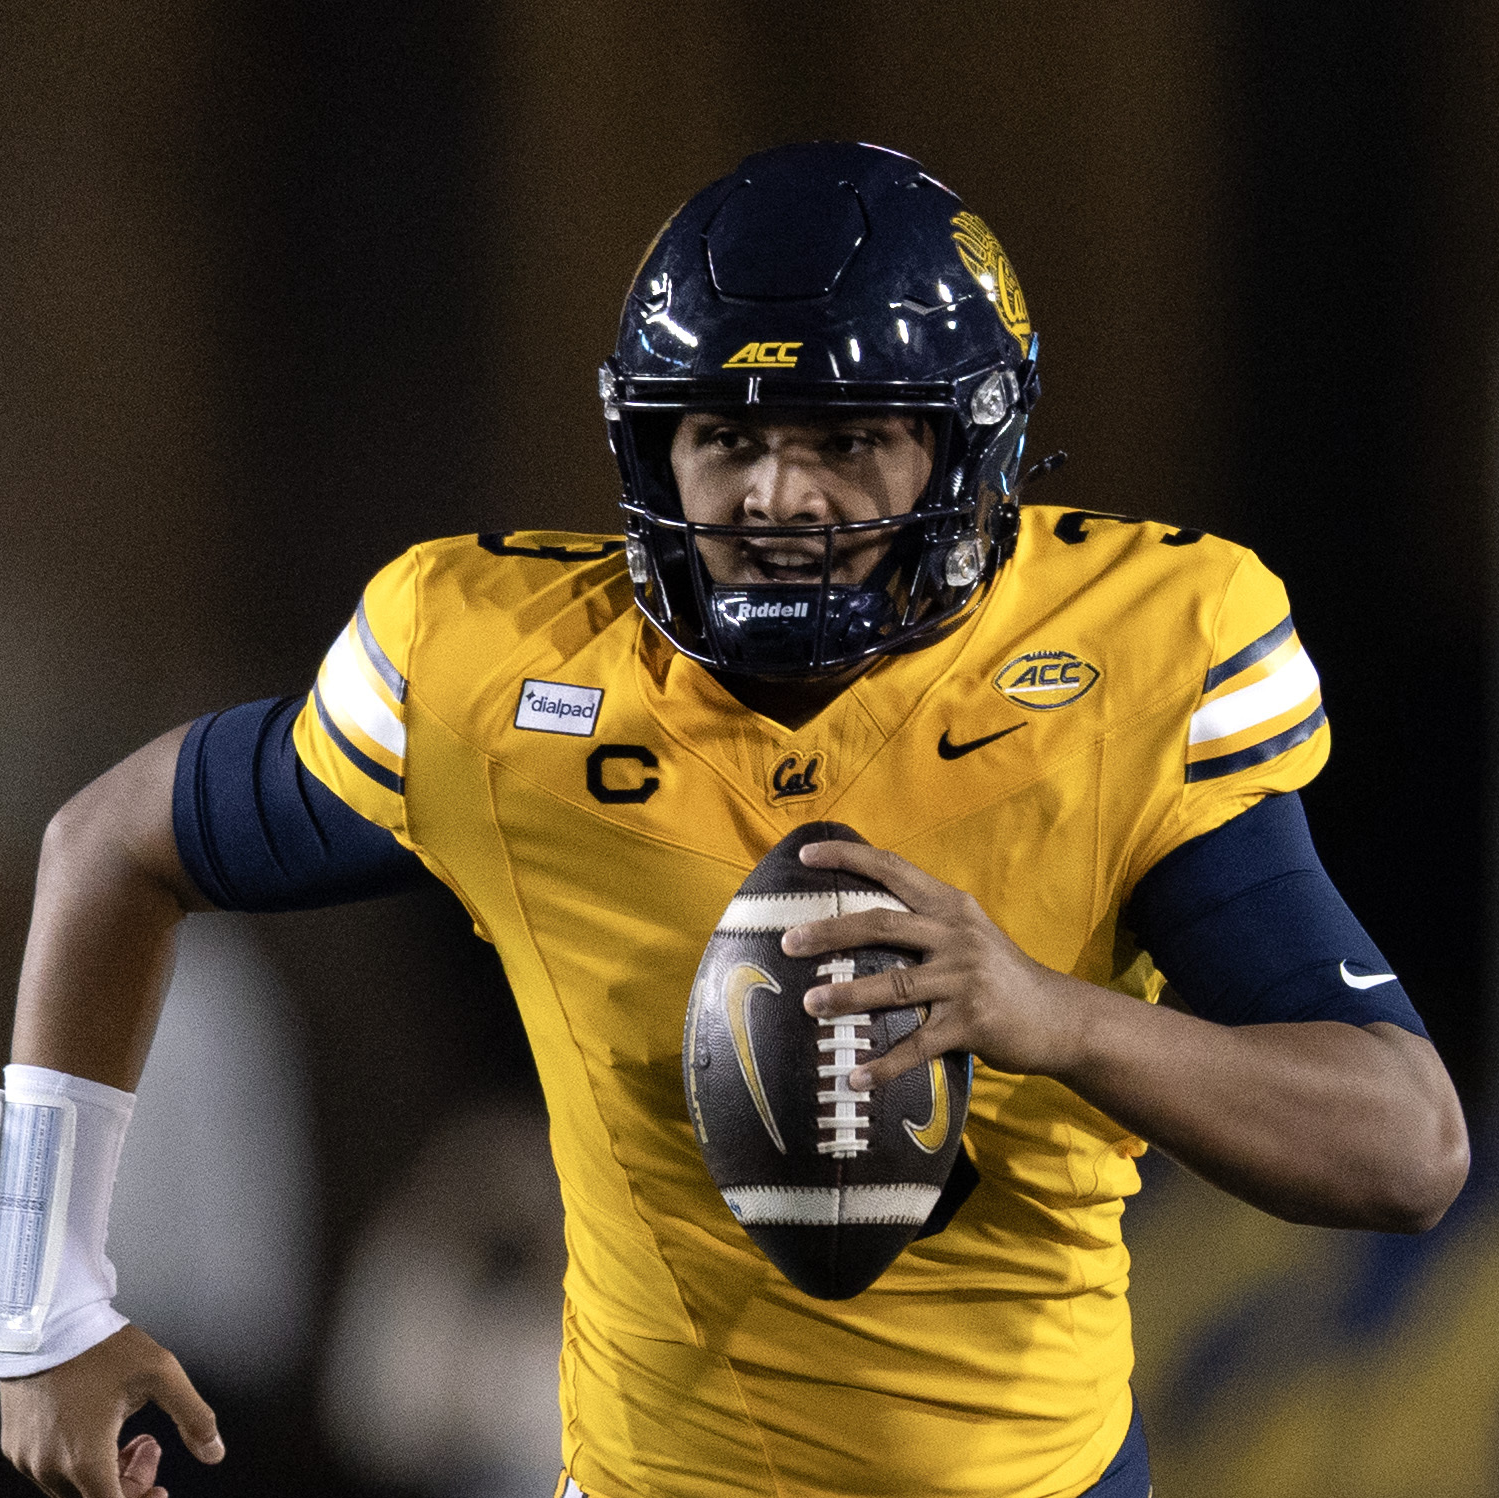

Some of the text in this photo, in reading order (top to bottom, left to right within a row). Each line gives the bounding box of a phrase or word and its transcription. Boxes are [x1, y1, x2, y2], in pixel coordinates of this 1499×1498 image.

[722, 341, 804, 369] ACC
[738, 602, 809, 618] Riddell
[1010, 661, 1083, 688] ACC
[531, 696, 596, 719] dialpad
[586, 743, 660, 804] C
[772, 757, 818, 801] Cal
